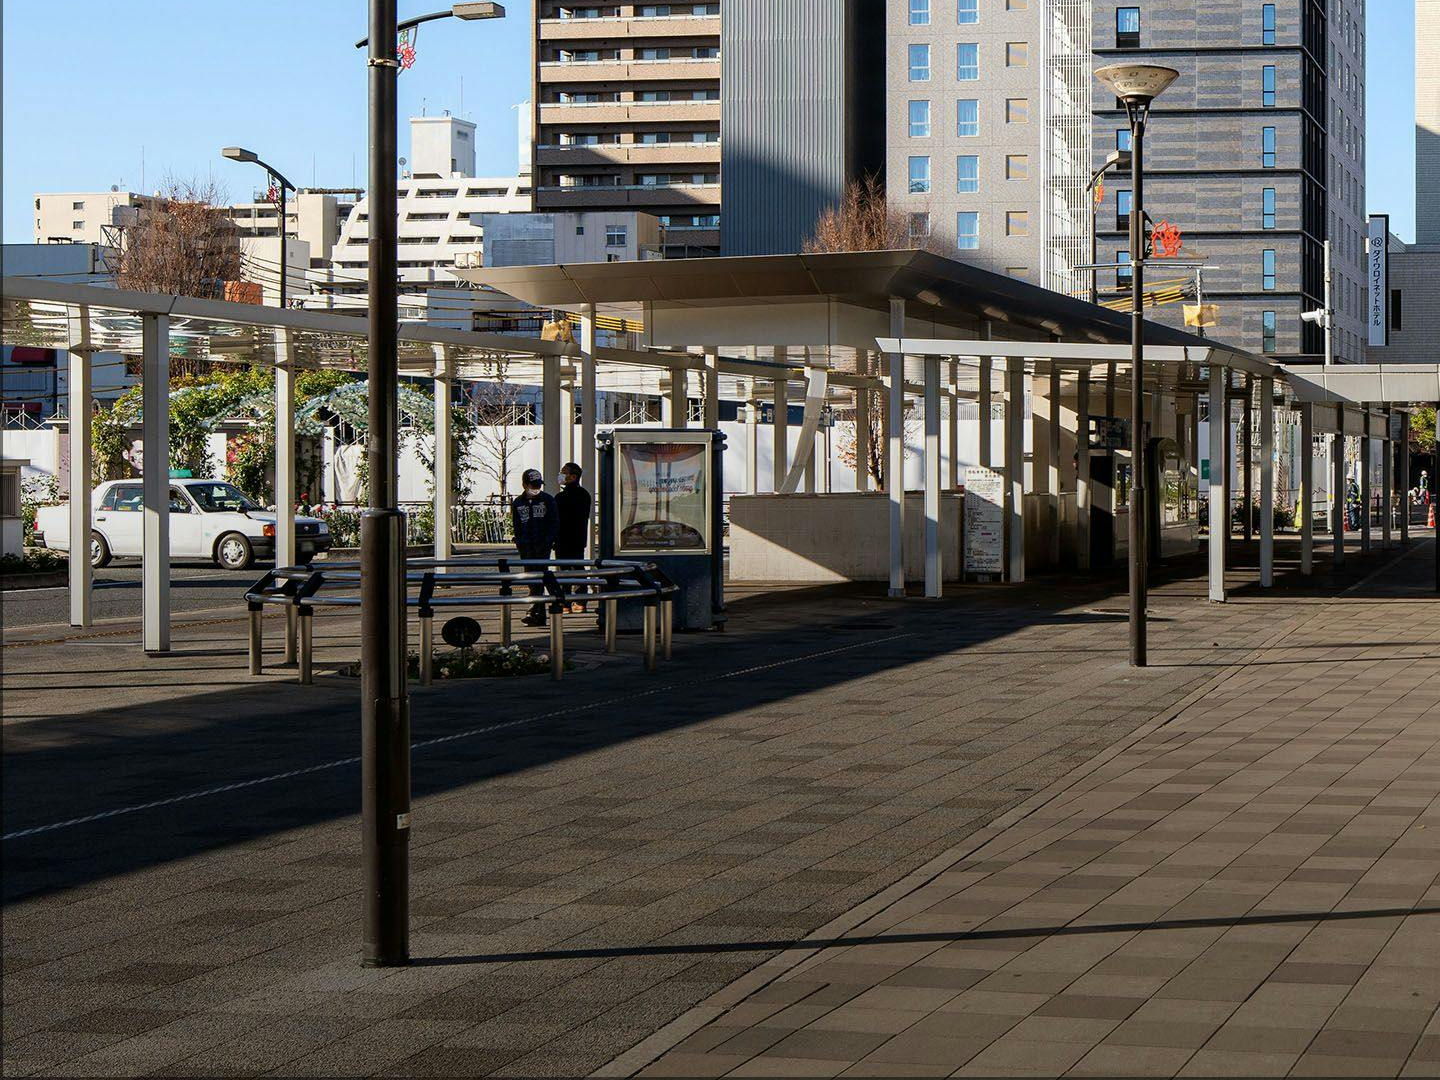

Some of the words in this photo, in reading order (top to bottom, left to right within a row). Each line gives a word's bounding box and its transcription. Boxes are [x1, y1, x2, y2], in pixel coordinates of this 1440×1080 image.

[1372, 249, 1381, 326] ダイワロイネットホテル
